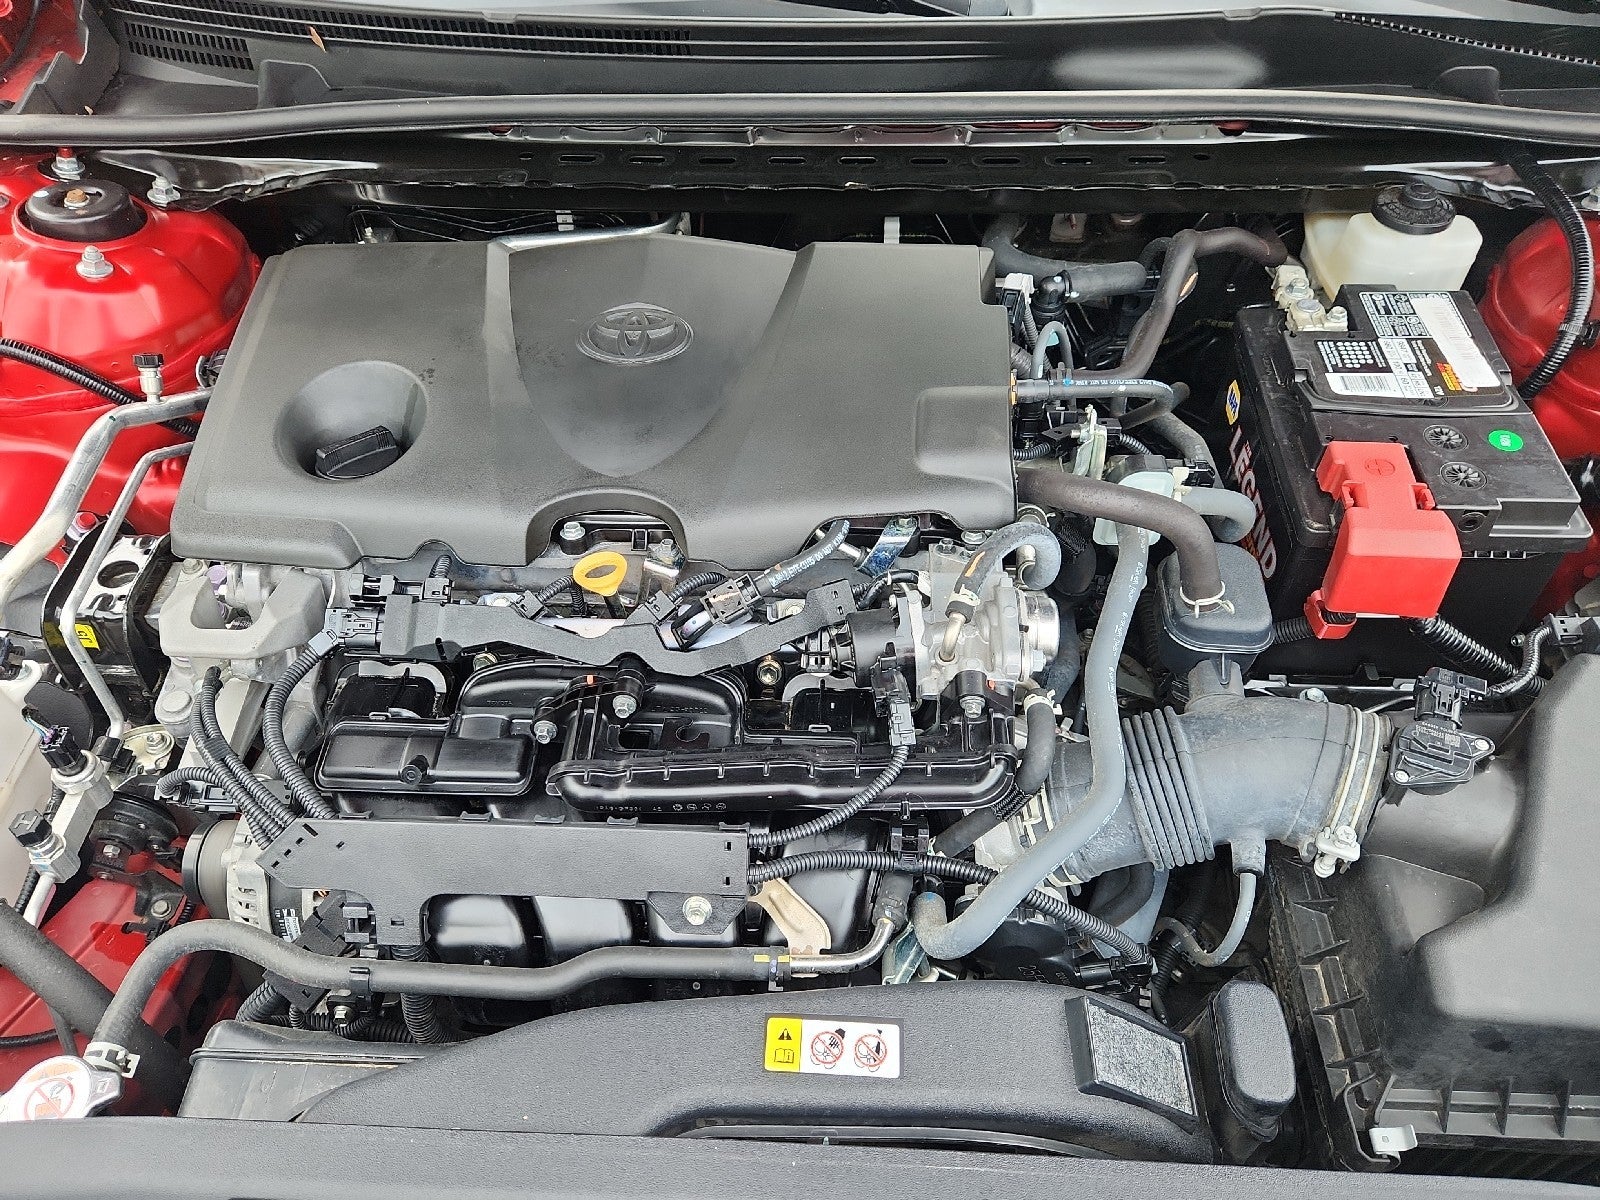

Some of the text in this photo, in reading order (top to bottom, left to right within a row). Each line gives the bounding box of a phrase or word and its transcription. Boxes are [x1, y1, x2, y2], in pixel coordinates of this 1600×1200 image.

[1433, 385, 1445, 396] 12V
[814, 551, 824, 562] DO
[822, 543, 834, 556] NOT
